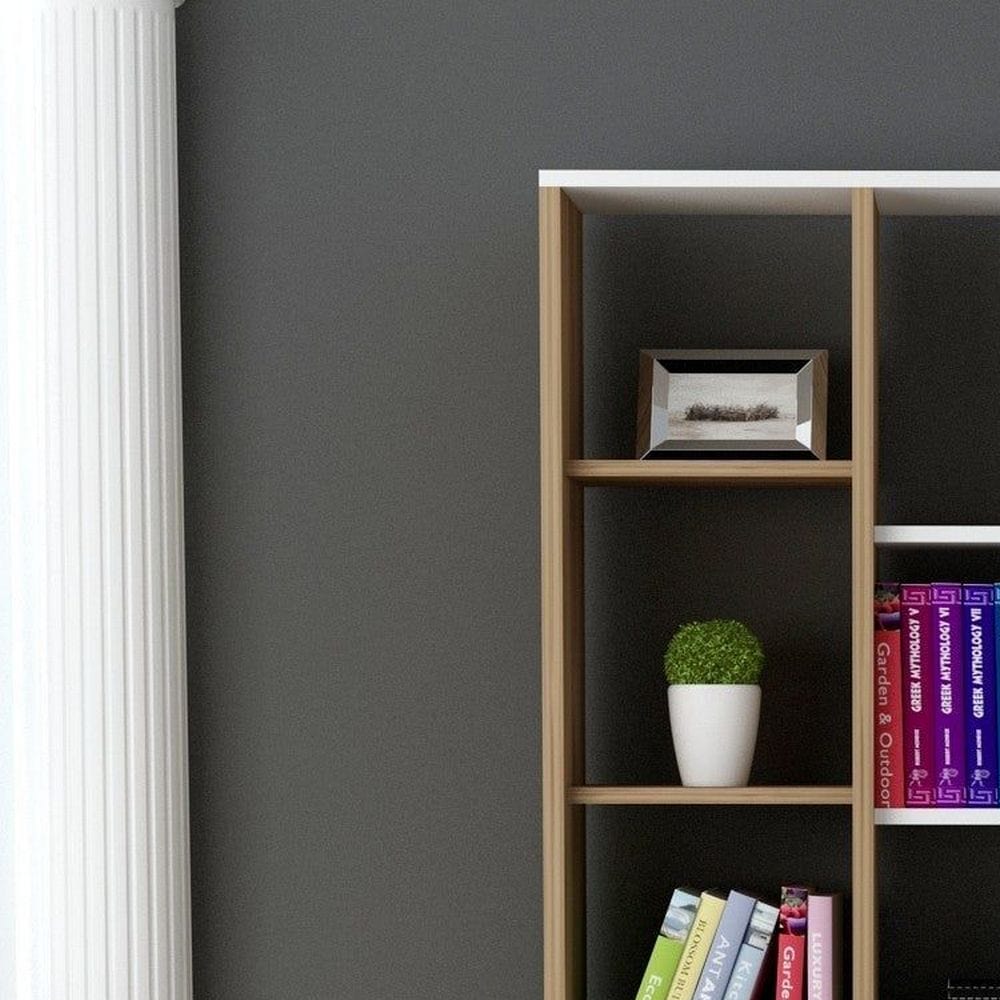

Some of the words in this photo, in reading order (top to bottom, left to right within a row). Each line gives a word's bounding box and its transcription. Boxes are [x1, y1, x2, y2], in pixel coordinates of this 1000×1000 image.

[908, 608, 920, 616] V
[938, 607, 950, 618] VI
[970, 608, 982, 622] VII
[908, 619, 920, 679] MYTHOLOGY
[939, 620, 951, 681] MYTHOLOGY
[971, 624, 983, 685] MYTHOLOGY
[877, 642, 891, 706] Garden
[910, 682, 922, 712] GREEK
[940, 684, 952, 714] GREEK
[972, 688, 984, 718] GREEK
[879, 713, 892, 725] &
[879, 732, 894, 808] Outdoor
[682, 920, 707, 976] BLOSSOM
